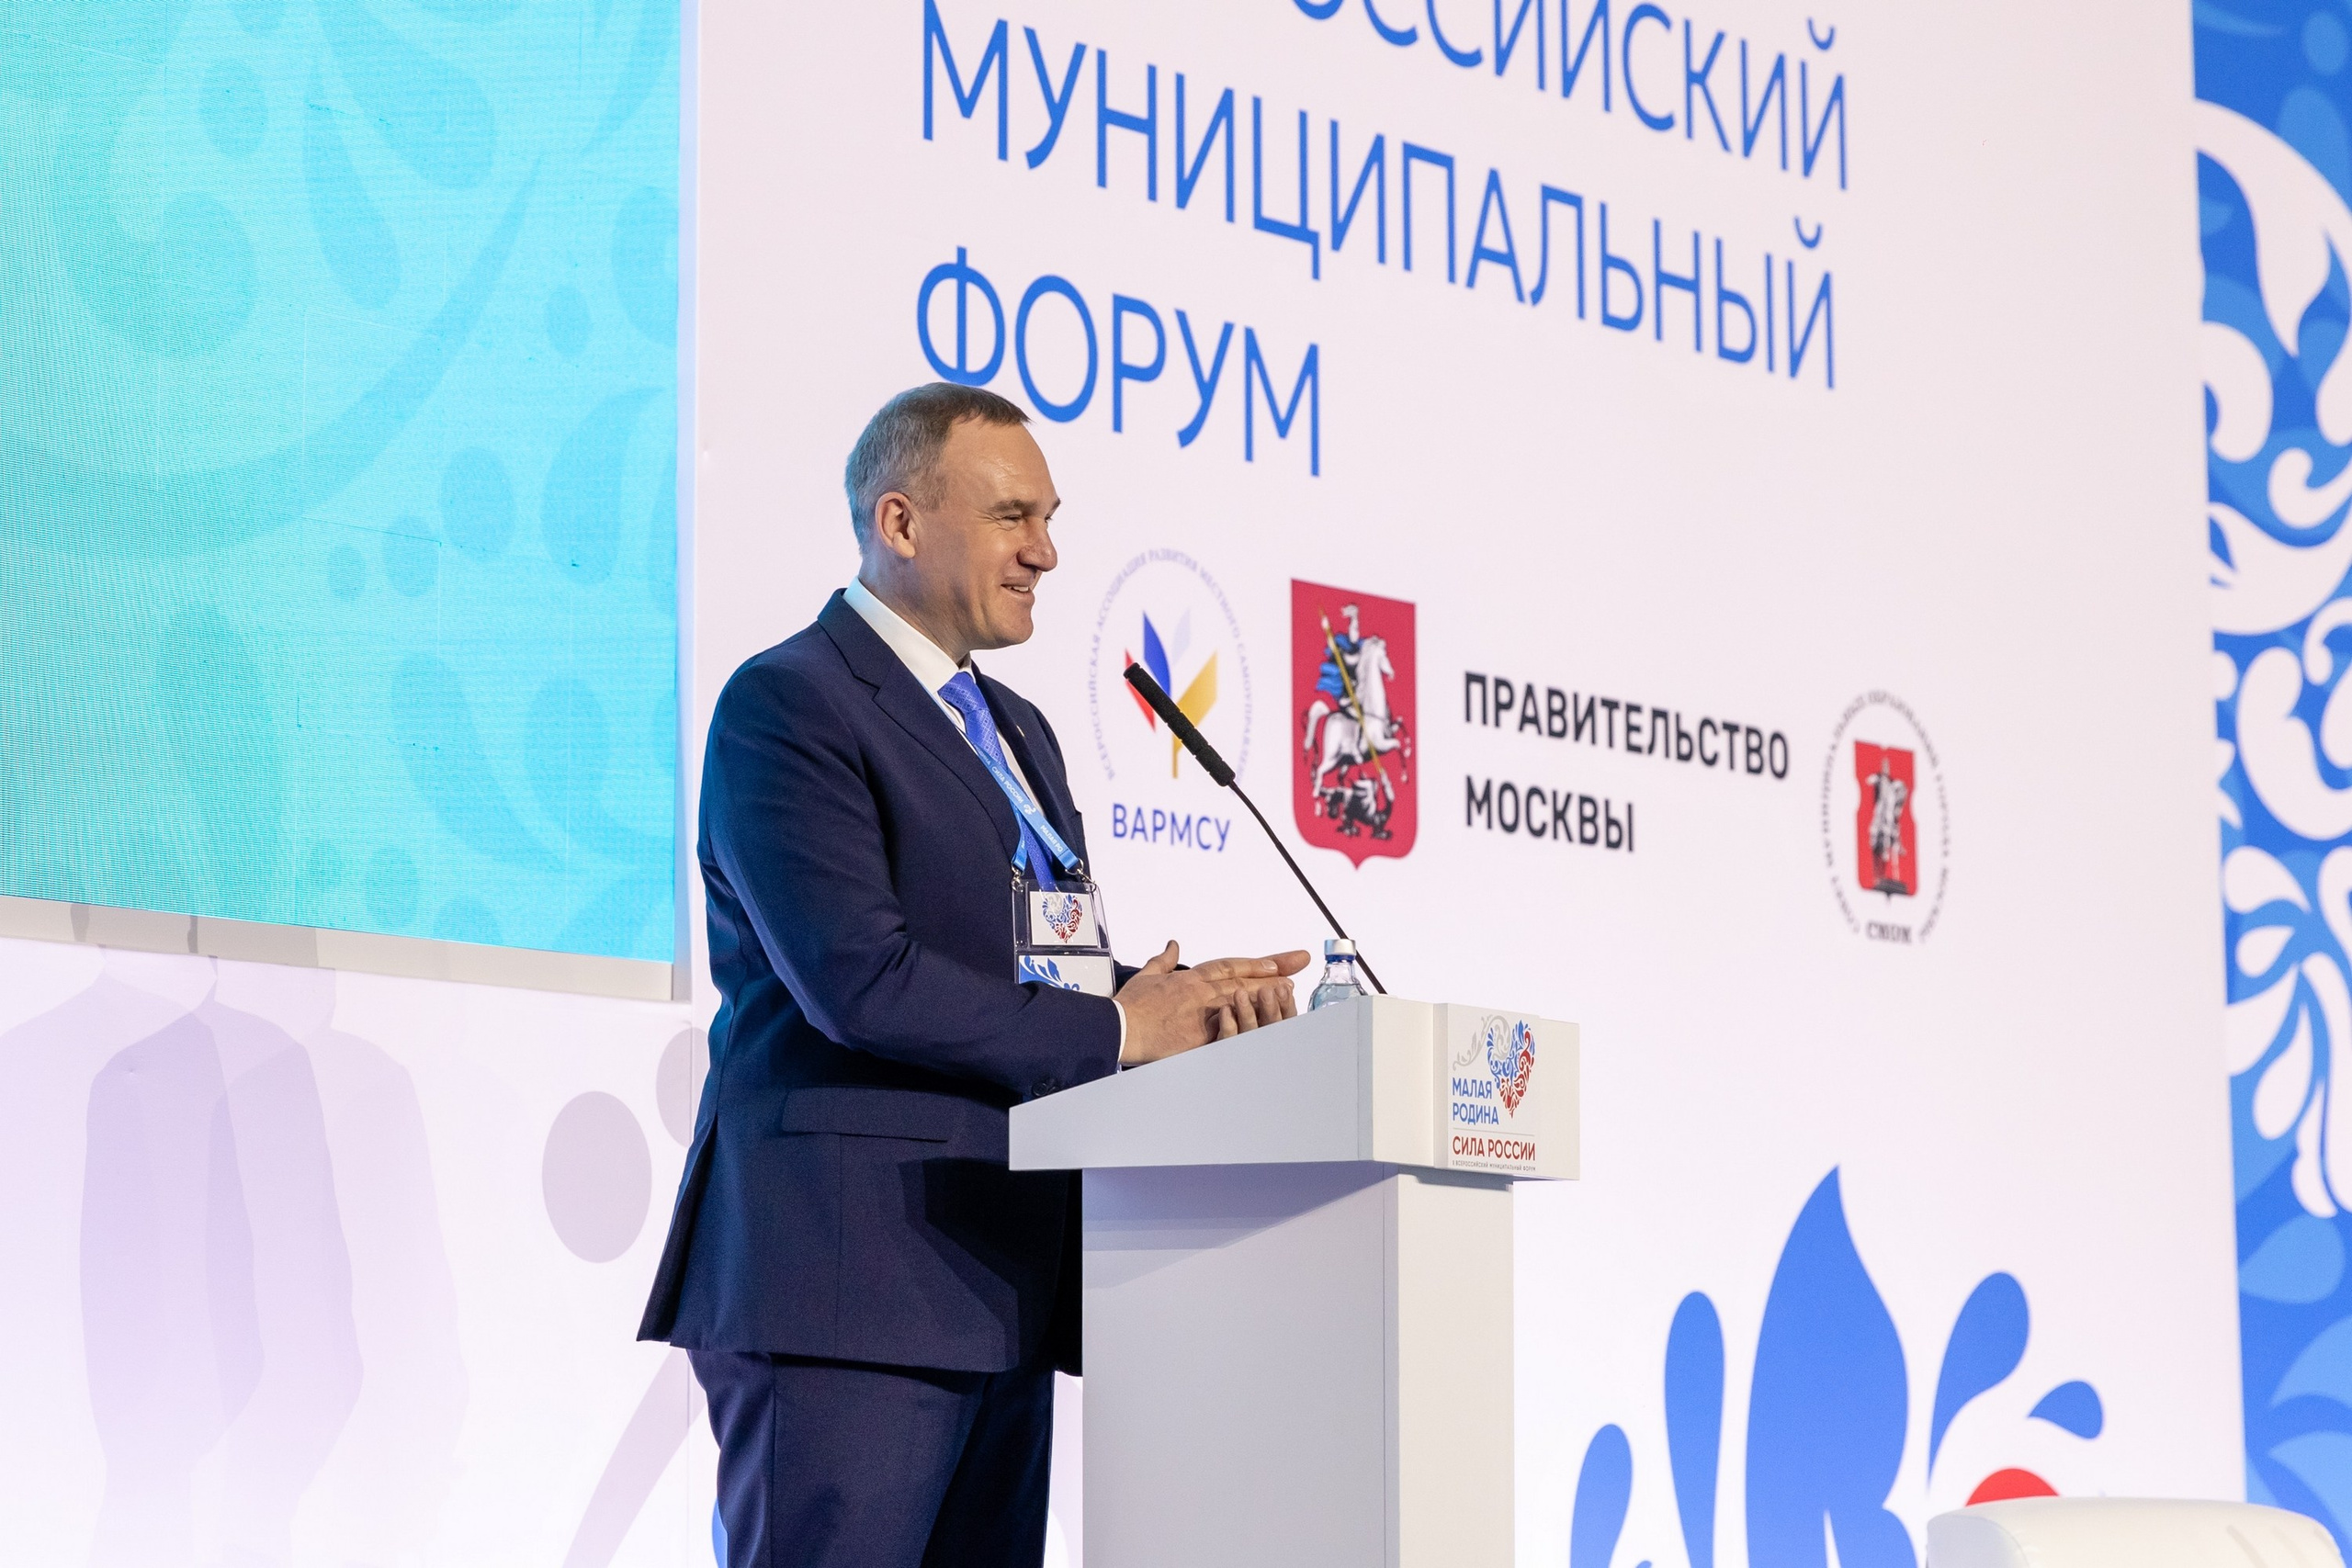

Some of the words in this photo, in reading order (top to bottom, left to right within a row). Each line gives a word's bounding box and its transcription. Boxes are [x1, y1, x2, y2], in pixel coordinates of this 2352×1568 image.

[922, 0, 1834, 389] МУНИЦИПАЛЬНЫЙ
[916, 245, 1320, 477] ФОРУМ
[1464, 671, 1789, 779] ПРАВИТЕЛЬСТВО
[991, 765, 1005, 783] СИЛА
[1003, 780, 1023, 804] РОССИИ
[1112, 802, 1231, 852] ВАРМСУ
[1465, 774, 1634, 852] МОСКВЫ
[1452, 1077, 1493, 1100] МАЛАЯ
[1453, 1102, 1499, 1125] РОДИНА
[1453, 1135, 1485, 1157] СИЛА
[1487, 1138, 1536, 1161] РОССИИ
